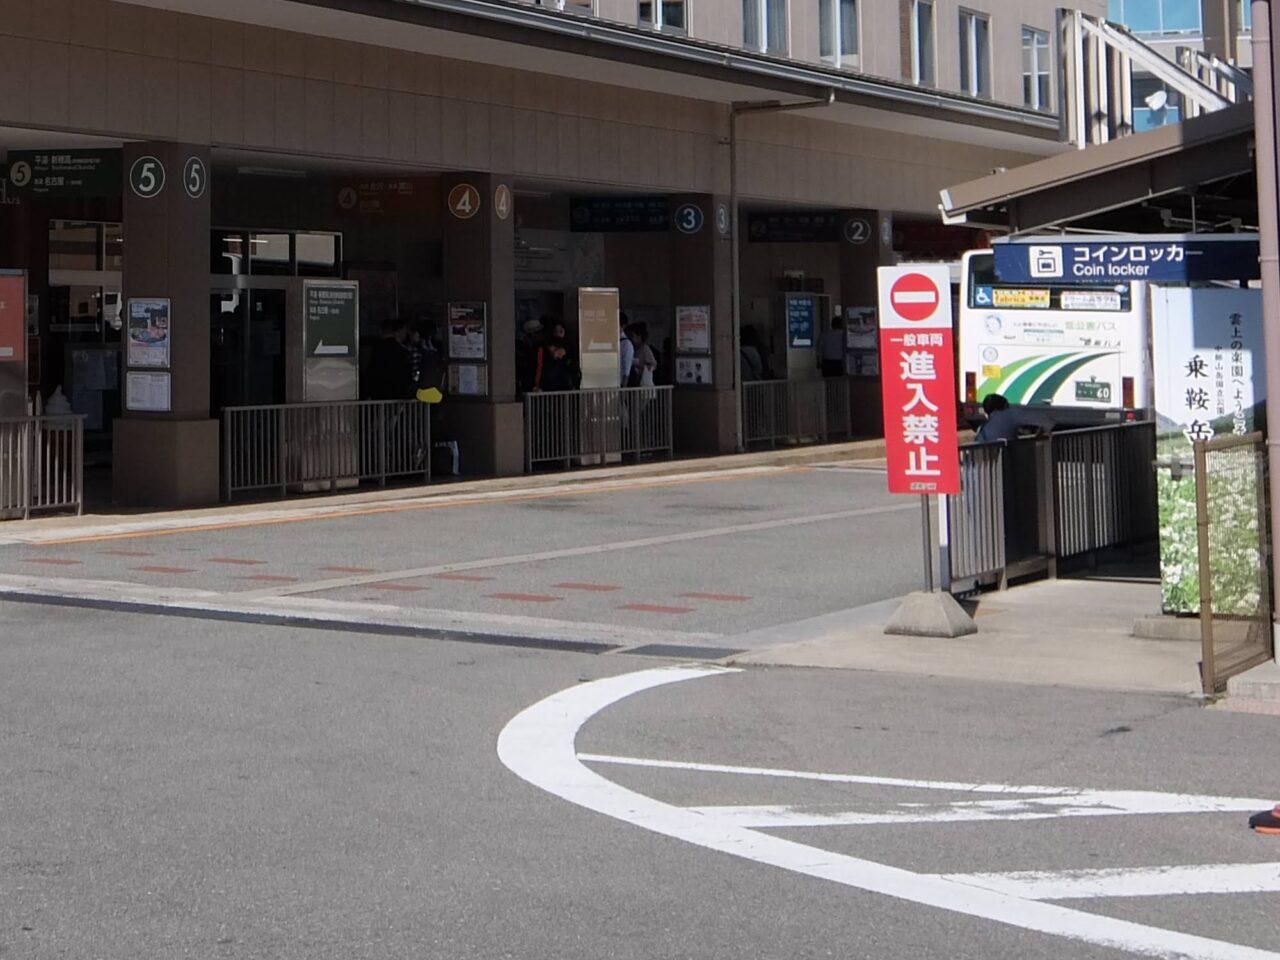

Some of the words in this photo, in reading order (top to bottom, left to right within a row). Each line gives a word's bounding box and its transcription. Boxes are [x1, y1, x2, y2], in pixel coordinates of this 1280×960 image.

[14, 163, 25, 182] 5
[138, 162, 156, 193] 5
[189, 163, 201, 192] 5
[455, 188, 473, 214] 4
[682, 207, 696, 230] 3
[851, 221, 865, 241] 2
[1073, 244, 1204, 262] コインロッカー
[1073, 263, 1105, 276] Coin
[1108, 263, 1150, 276] locker
[889, 333, 944, 347] 一般車両
[1184, 354, 1212, 442] 乗鞍岳
[899, 350, 942, 477] 進入禁止
